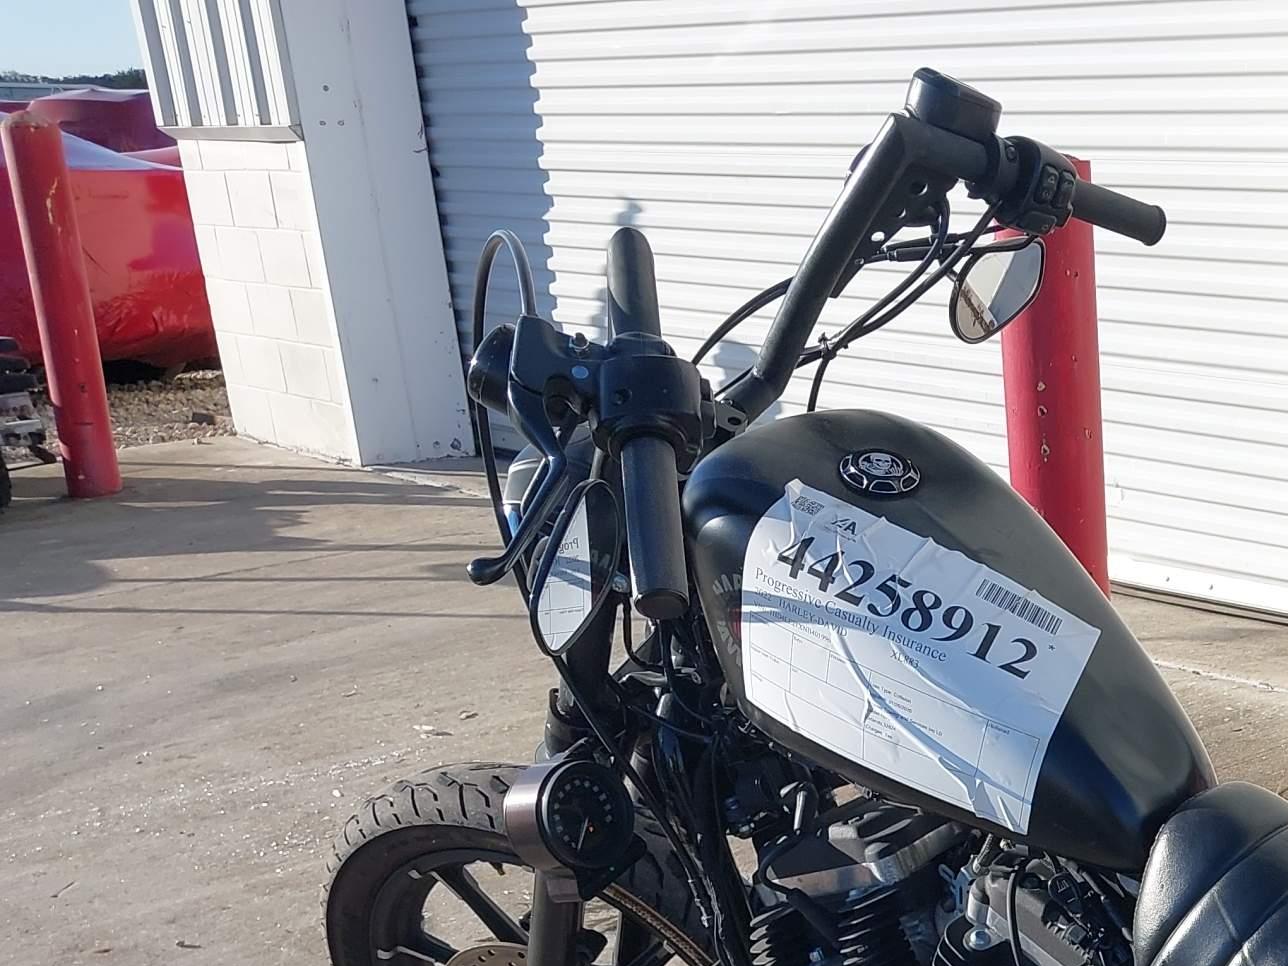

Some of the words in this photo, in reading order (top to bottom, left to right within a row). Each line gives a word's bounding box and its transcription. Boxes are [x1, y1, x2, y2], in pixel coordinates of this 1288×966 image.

[755, 567, 822, 609] Progressive
[825, 600, 881, 636] Casualty
[882, 625, 947, 662] Insurance
[777, 536, 1038, 680] 44258912
